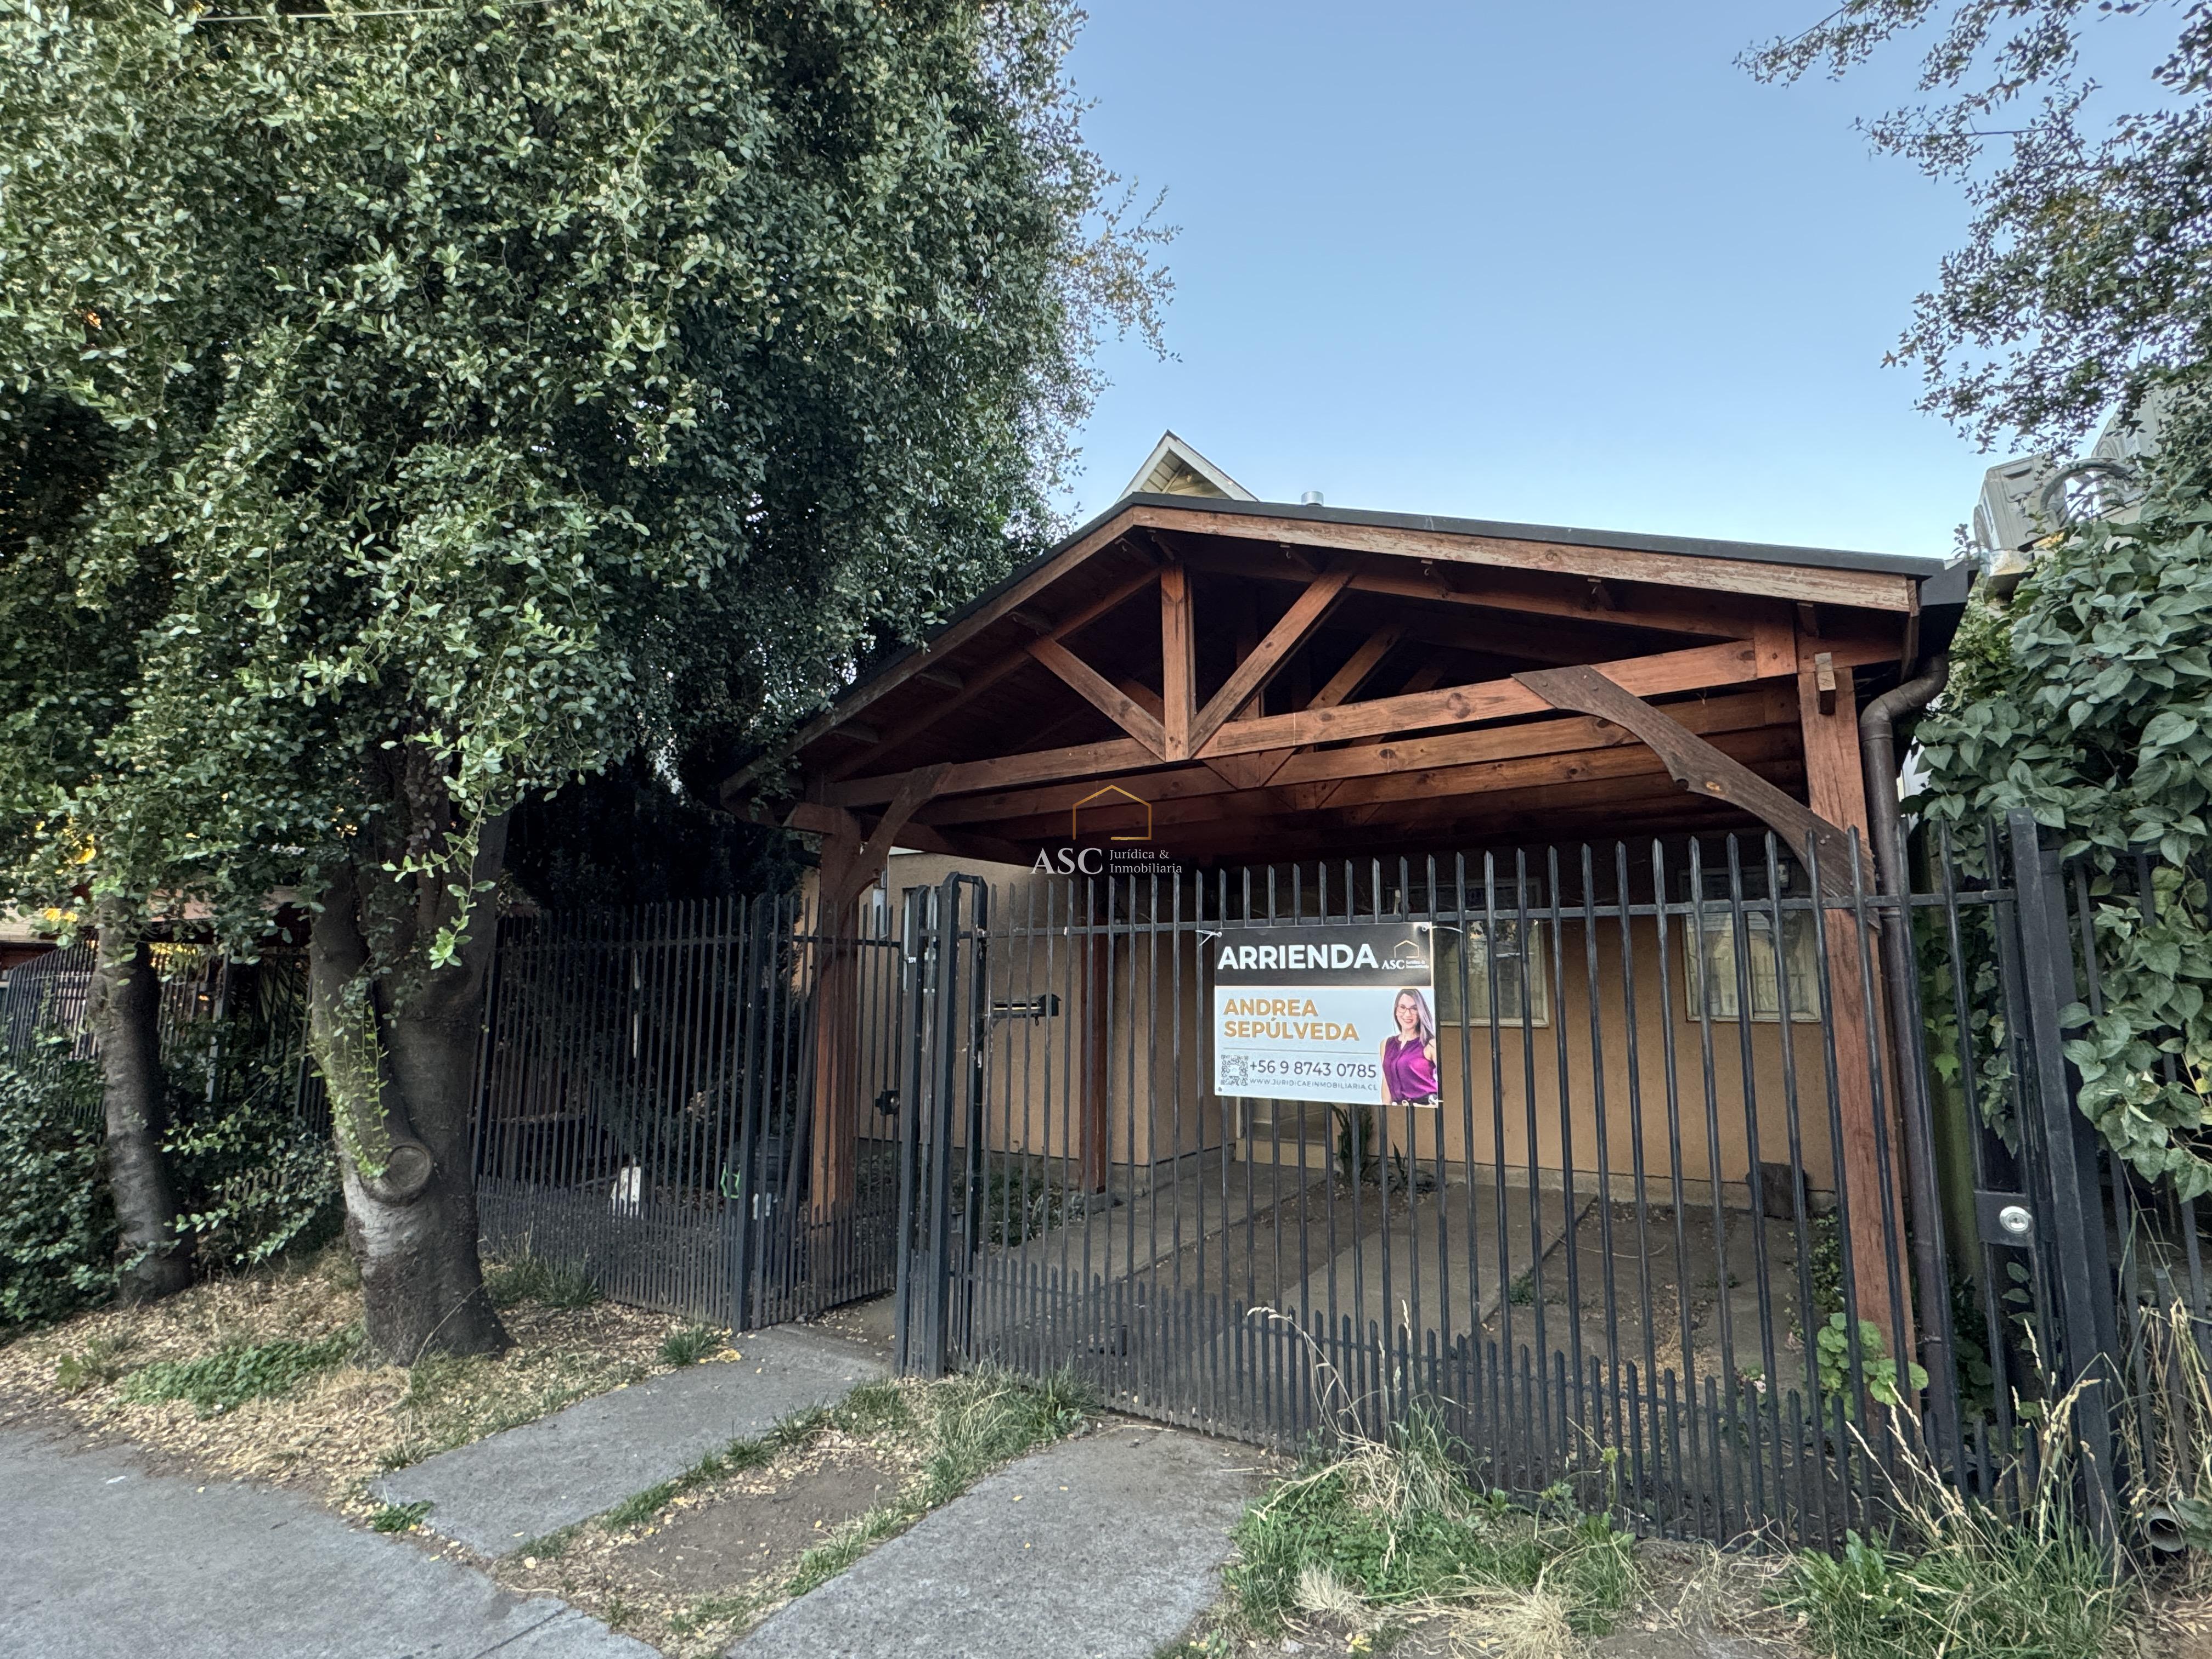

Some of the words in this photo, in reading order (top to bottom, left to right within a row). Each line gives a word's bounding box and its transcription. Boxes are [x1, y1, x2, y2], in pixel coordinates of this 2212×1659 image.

[1217, 944, 1379, 969] ARRIENDA
[1381, 960, 1404, 969] ASC
[1223, 998, 1318, 1017] ANDREA
[1224, 1017, 1359, 1041] SEPÚLVEDA
[1250, 1060, 1276, 1074] +56
[1280, 1060, 1289, 1074] 9
[1294, 1061, 1331, 1075] 8743
[1336, 1063, 1376, 1078] 0785
